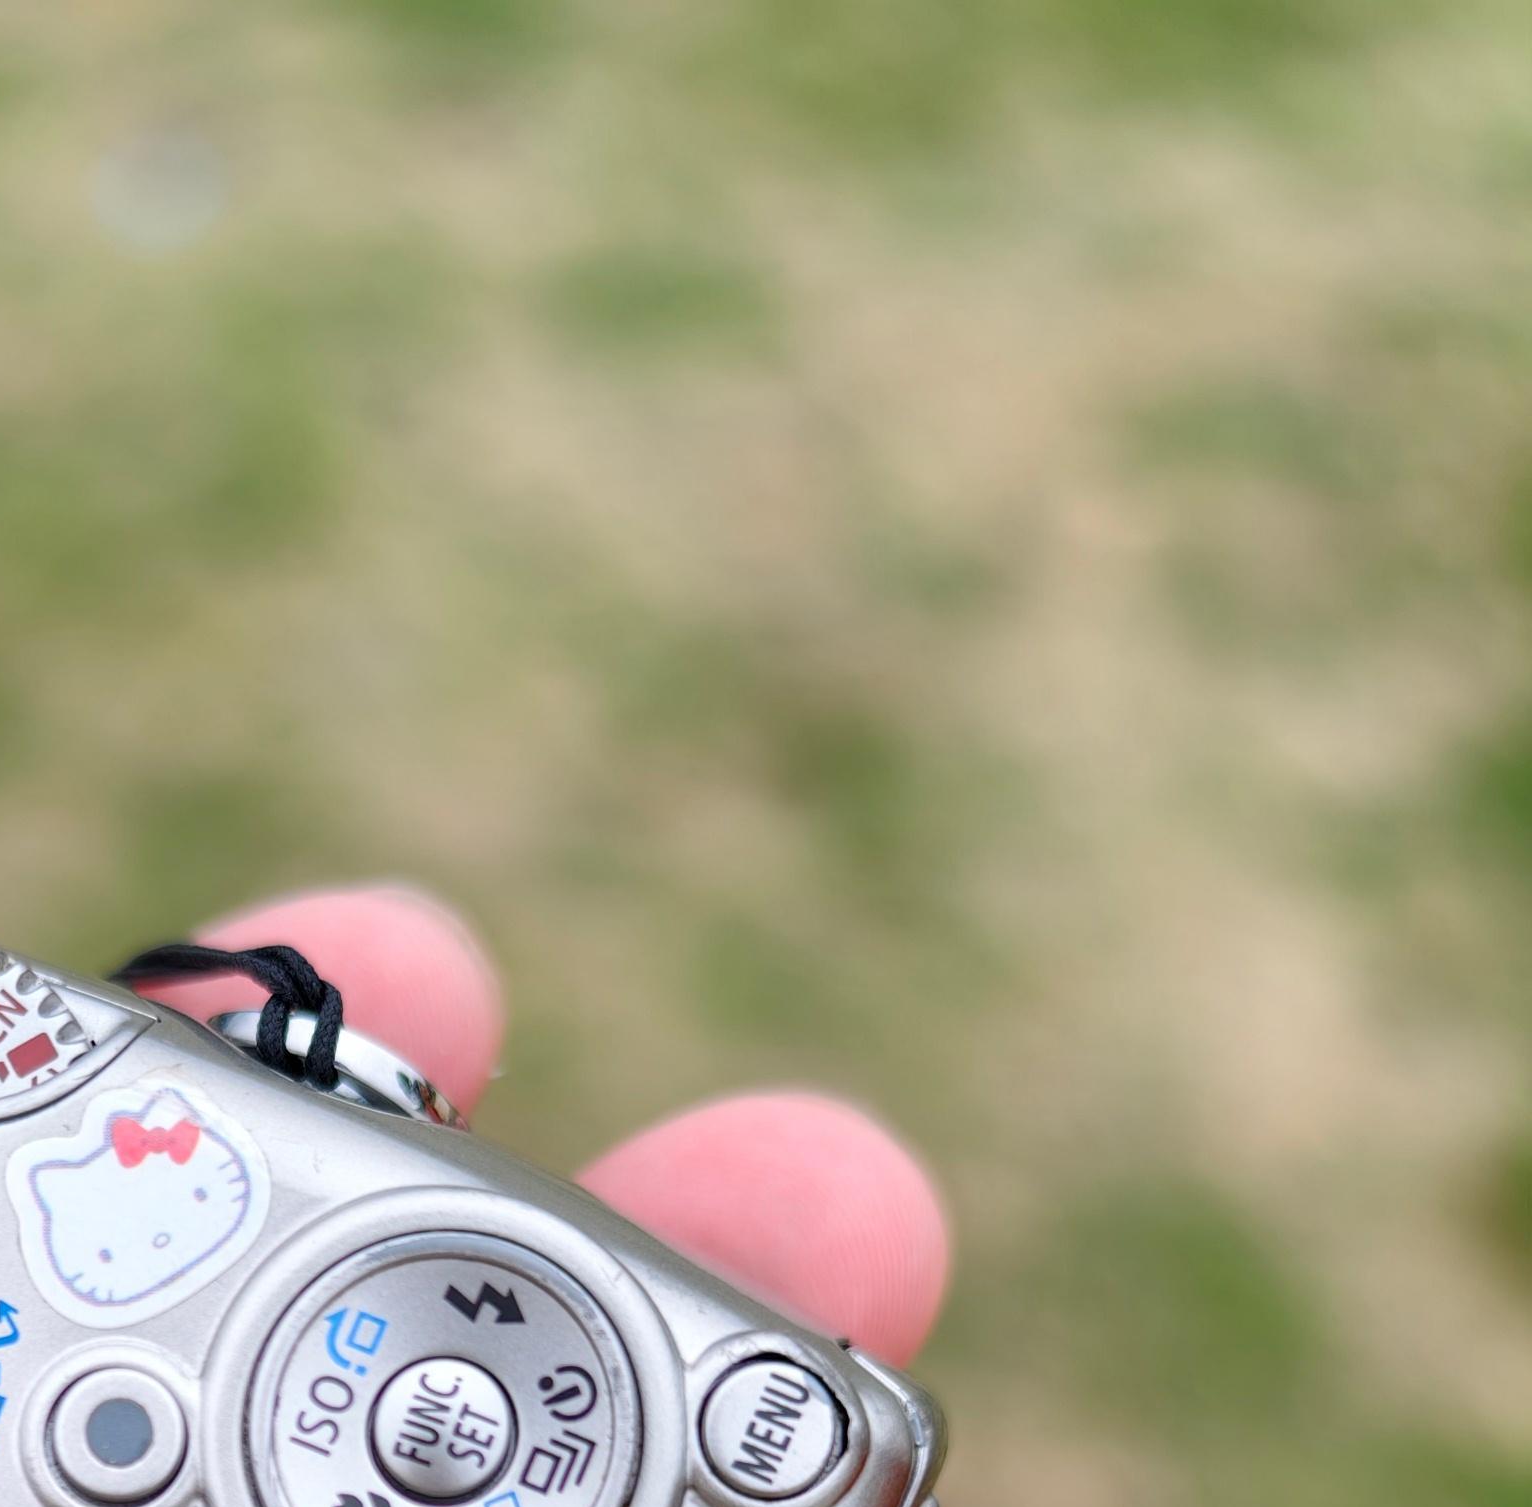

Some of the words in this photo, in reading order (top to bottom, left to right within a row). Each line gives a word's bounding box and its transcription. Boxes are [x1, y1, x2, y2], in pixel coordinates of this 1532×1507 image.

[290, 1375, 355, 1457] ISO
[394, 1372, 462, 1468] FUNC.
[448, 1403, 501, 1470] SET
[732, 1372, 812, 1484] MENU
